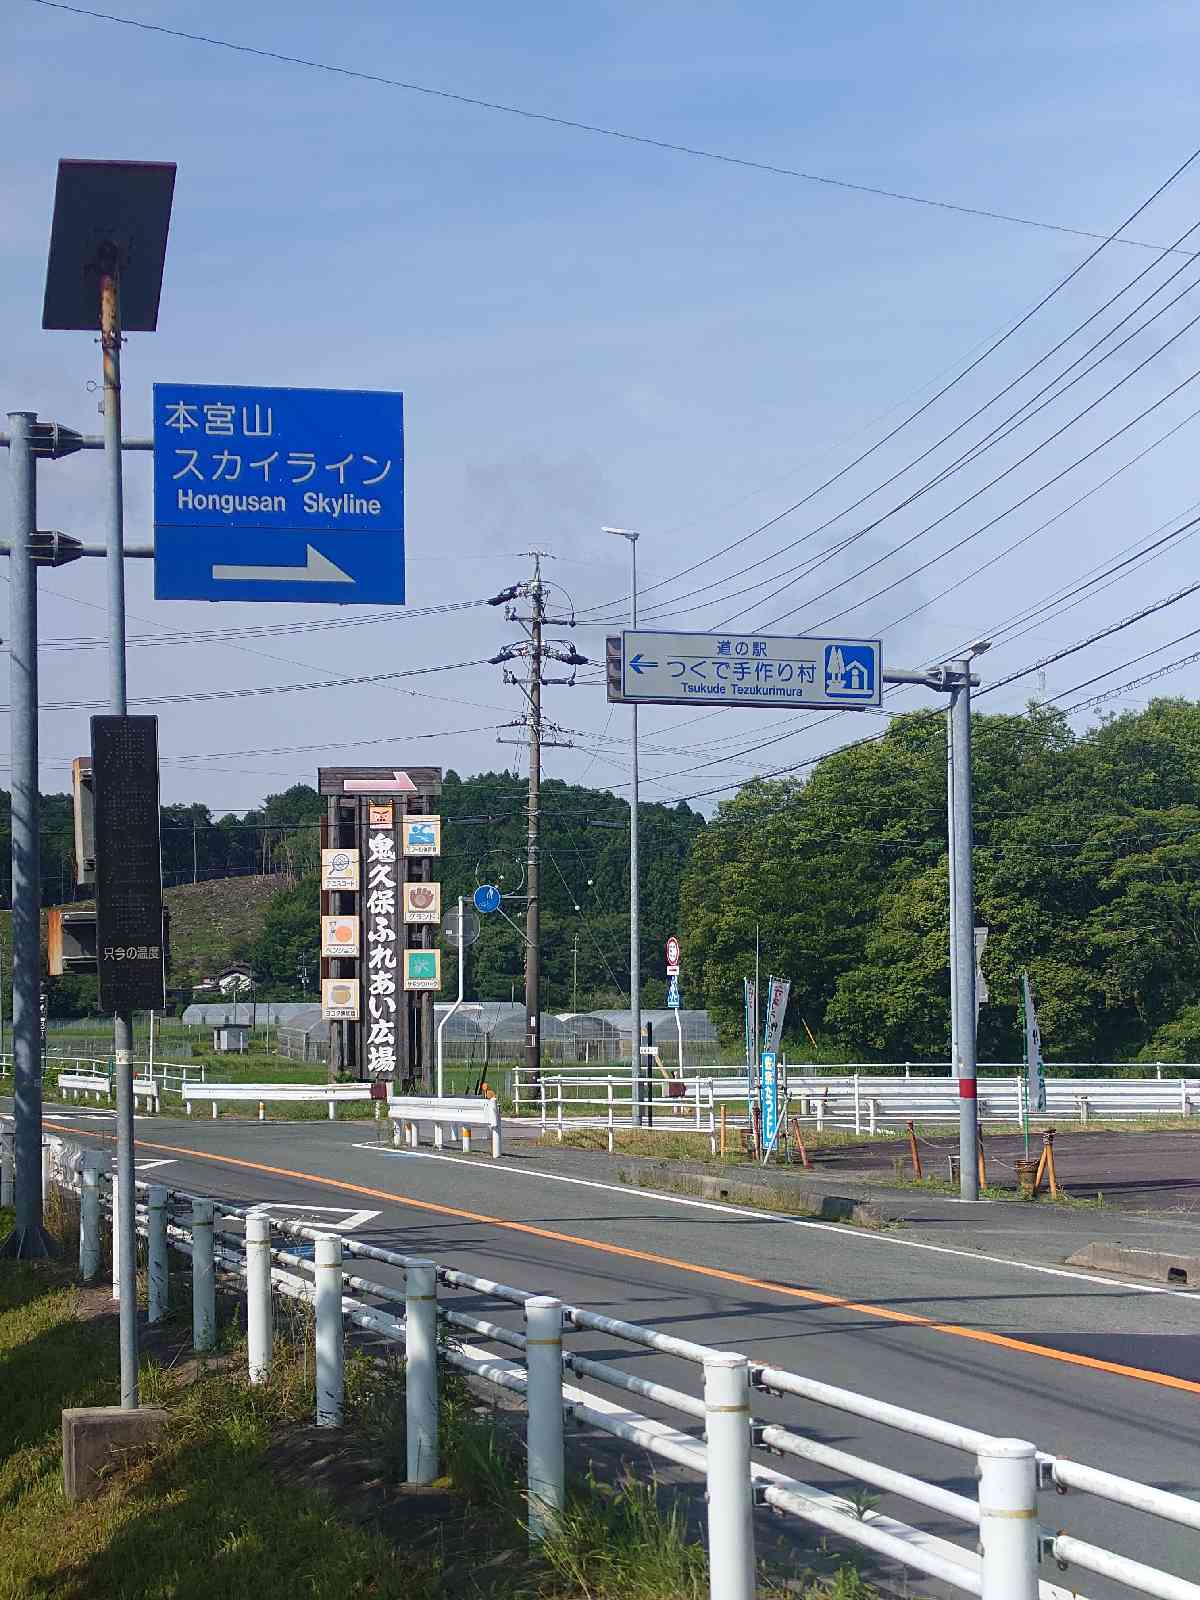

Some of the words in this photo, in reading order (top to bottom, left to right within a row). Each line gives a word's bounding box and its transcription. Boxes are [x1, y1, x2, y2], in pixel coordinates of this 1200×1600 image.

[164, 400, 273, 436] 本宮山
[172, 449, 391, 485] スカイライン
[177, 489, 286, 514] Hongusan
[303, 492, 381, 517] Skyline
[716, 640, 768, 657] 道の駅
[666, 661, 817, 684] つくで手作り村
[680, 682, 726, 694] Tsukude
[731, 684, 803, 697] Tezukurimura
[103, 945, 161, 960] 只今の温度
[367, 832, 397, 1073] 鬼久保ふれあい広場
